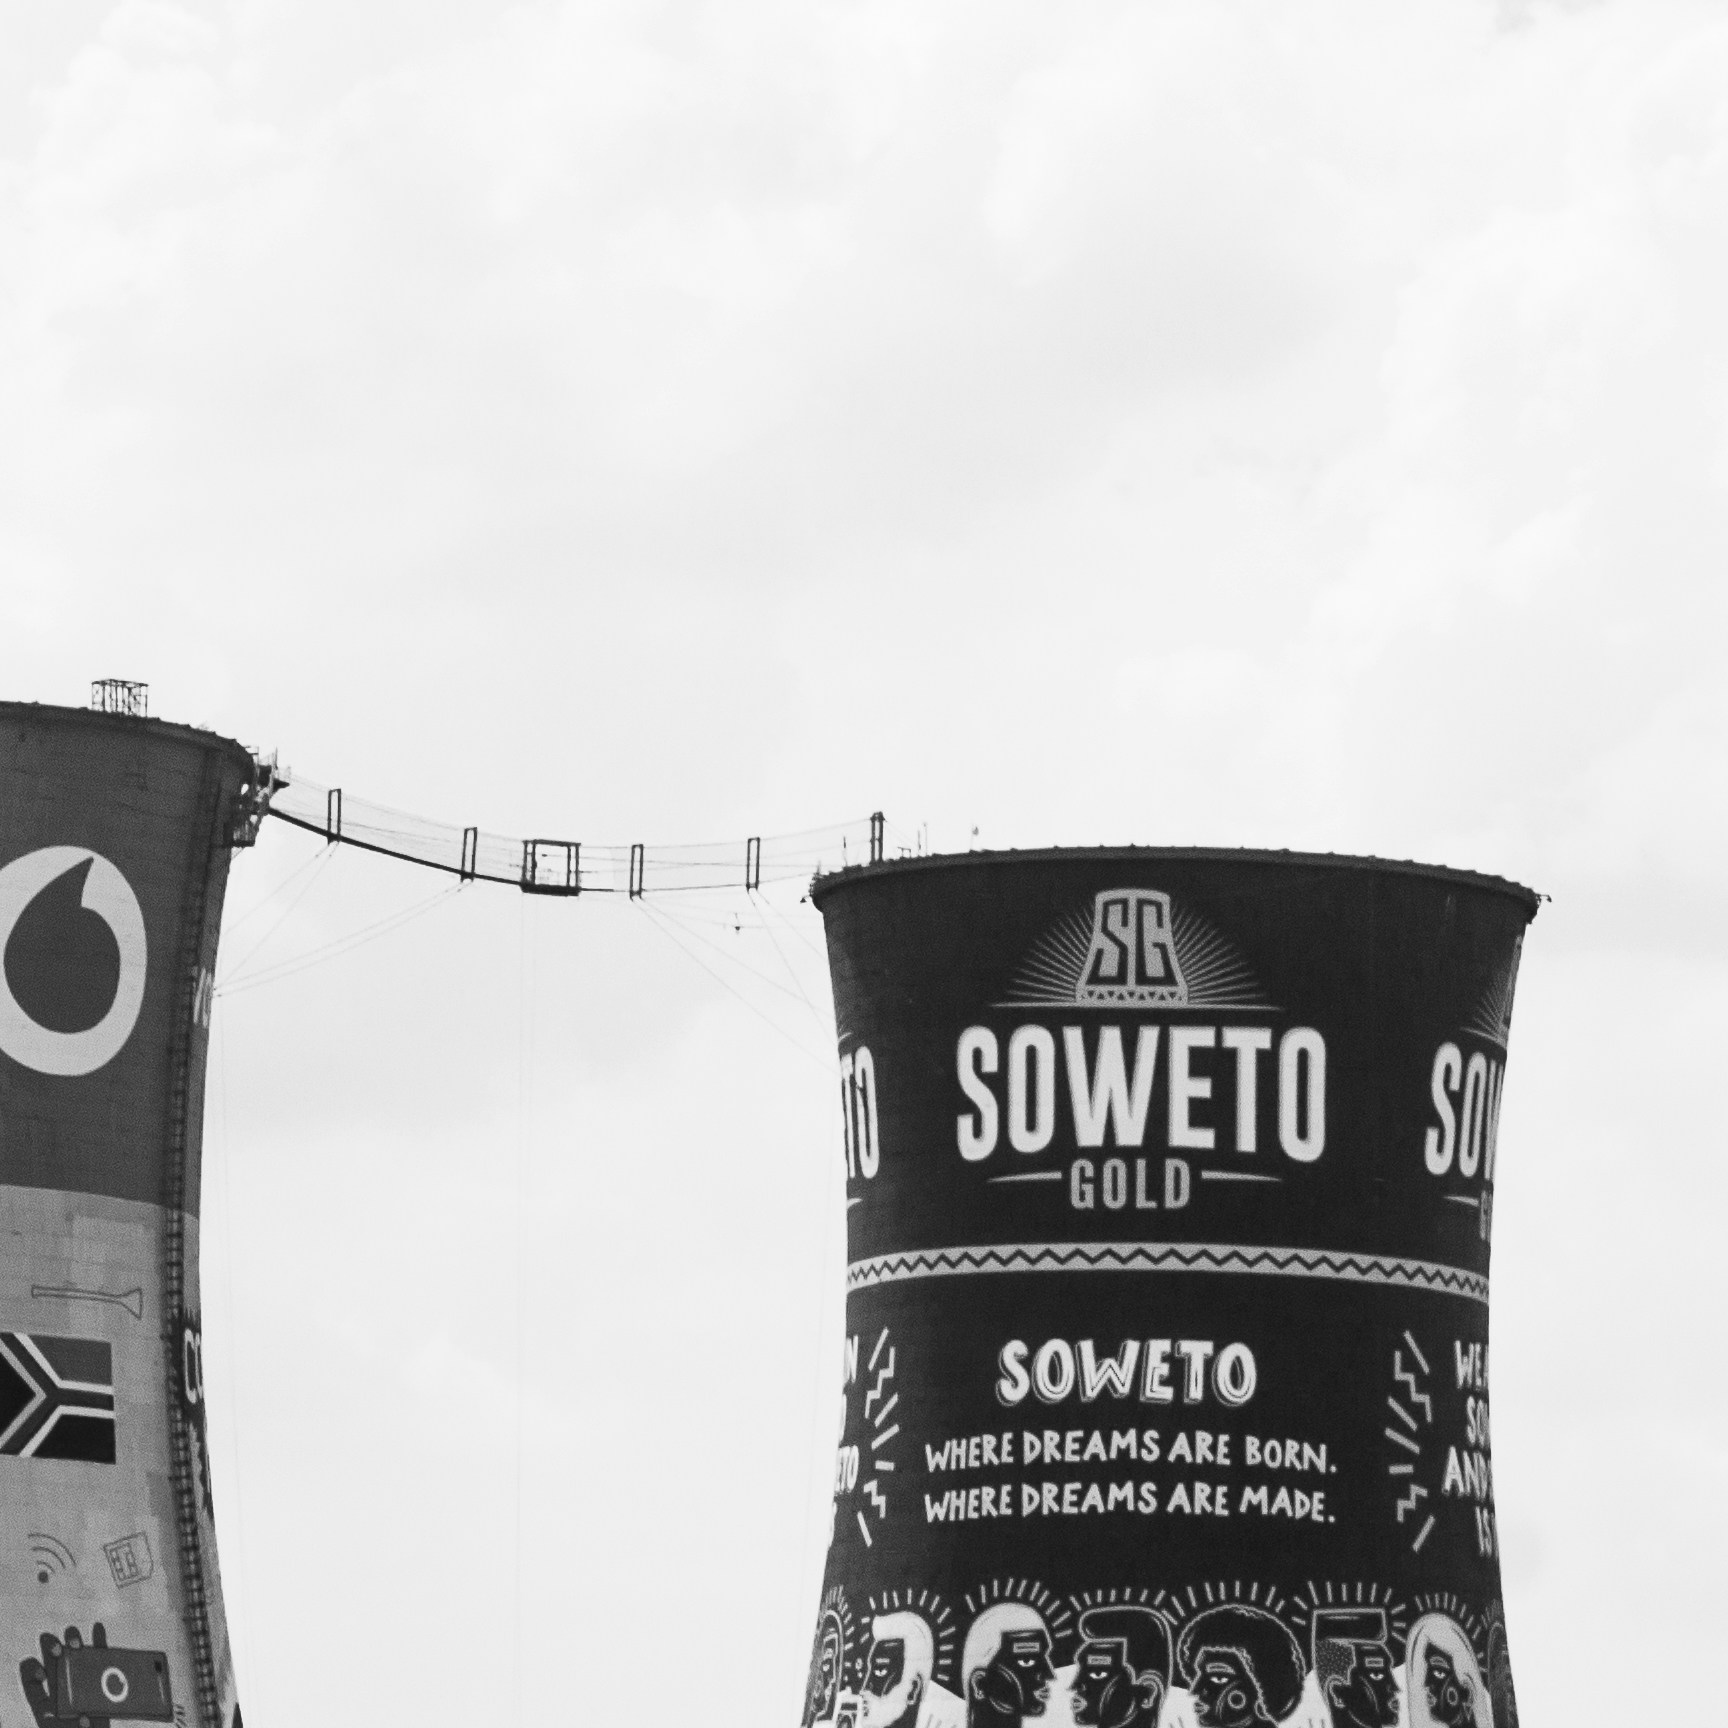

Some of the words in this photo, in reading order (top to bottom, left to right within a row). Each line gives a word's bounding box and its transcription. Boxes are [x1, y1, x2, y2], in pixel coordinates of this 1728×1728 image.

[956, 1024, 1327, 1163] SOWETO
[1070, 1157, 1191, 1210] GOLD
[996, 1338, 1257, 1405] SOWETO
[924, 1438, 1014, 1473] WHERE
[1022, 1427, 1161, 1465] DREAMS
[1167, 1430, 1231, 1466] ARE
[1245, 1435, 1338, 1474] BORN.
[924, 1487, 1013, 1523] WHERE
[1021, 1480, 1158, 1518] DREAMS
[1166, 1481, 1230, 1517] ARE
[1239, 1485, 1336, 1523] MADE.
